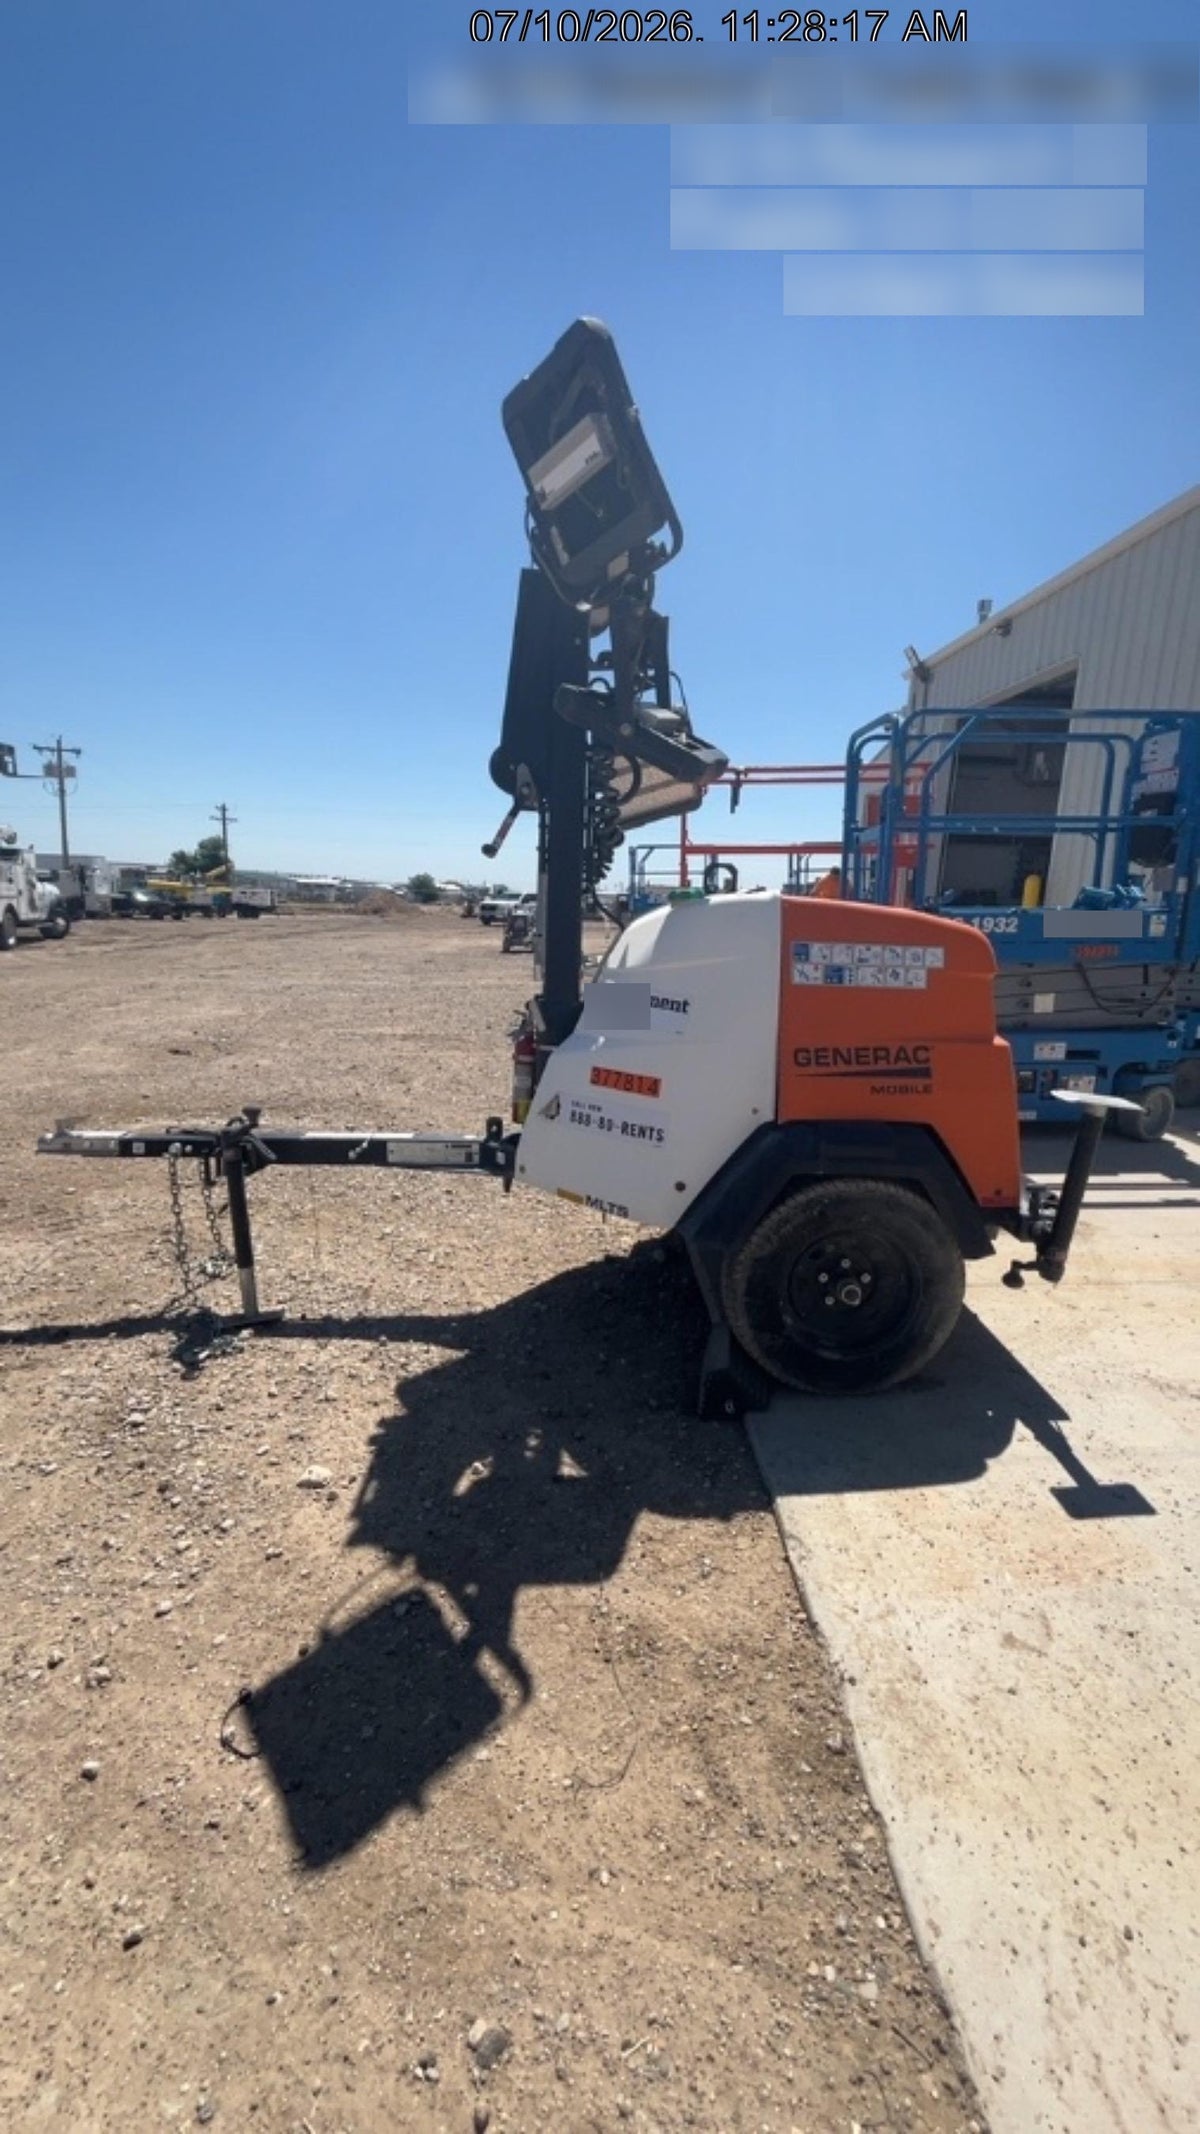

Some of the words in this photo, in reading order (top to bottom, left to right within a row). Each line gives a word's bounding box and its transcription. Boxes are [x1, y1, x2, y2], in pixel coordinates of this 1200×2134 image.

[794, 1046, 930, 1067] GENERAC
[590, 1066, 661, 1097] 377814
[870, 1084, 933, 1095] MOBILE
